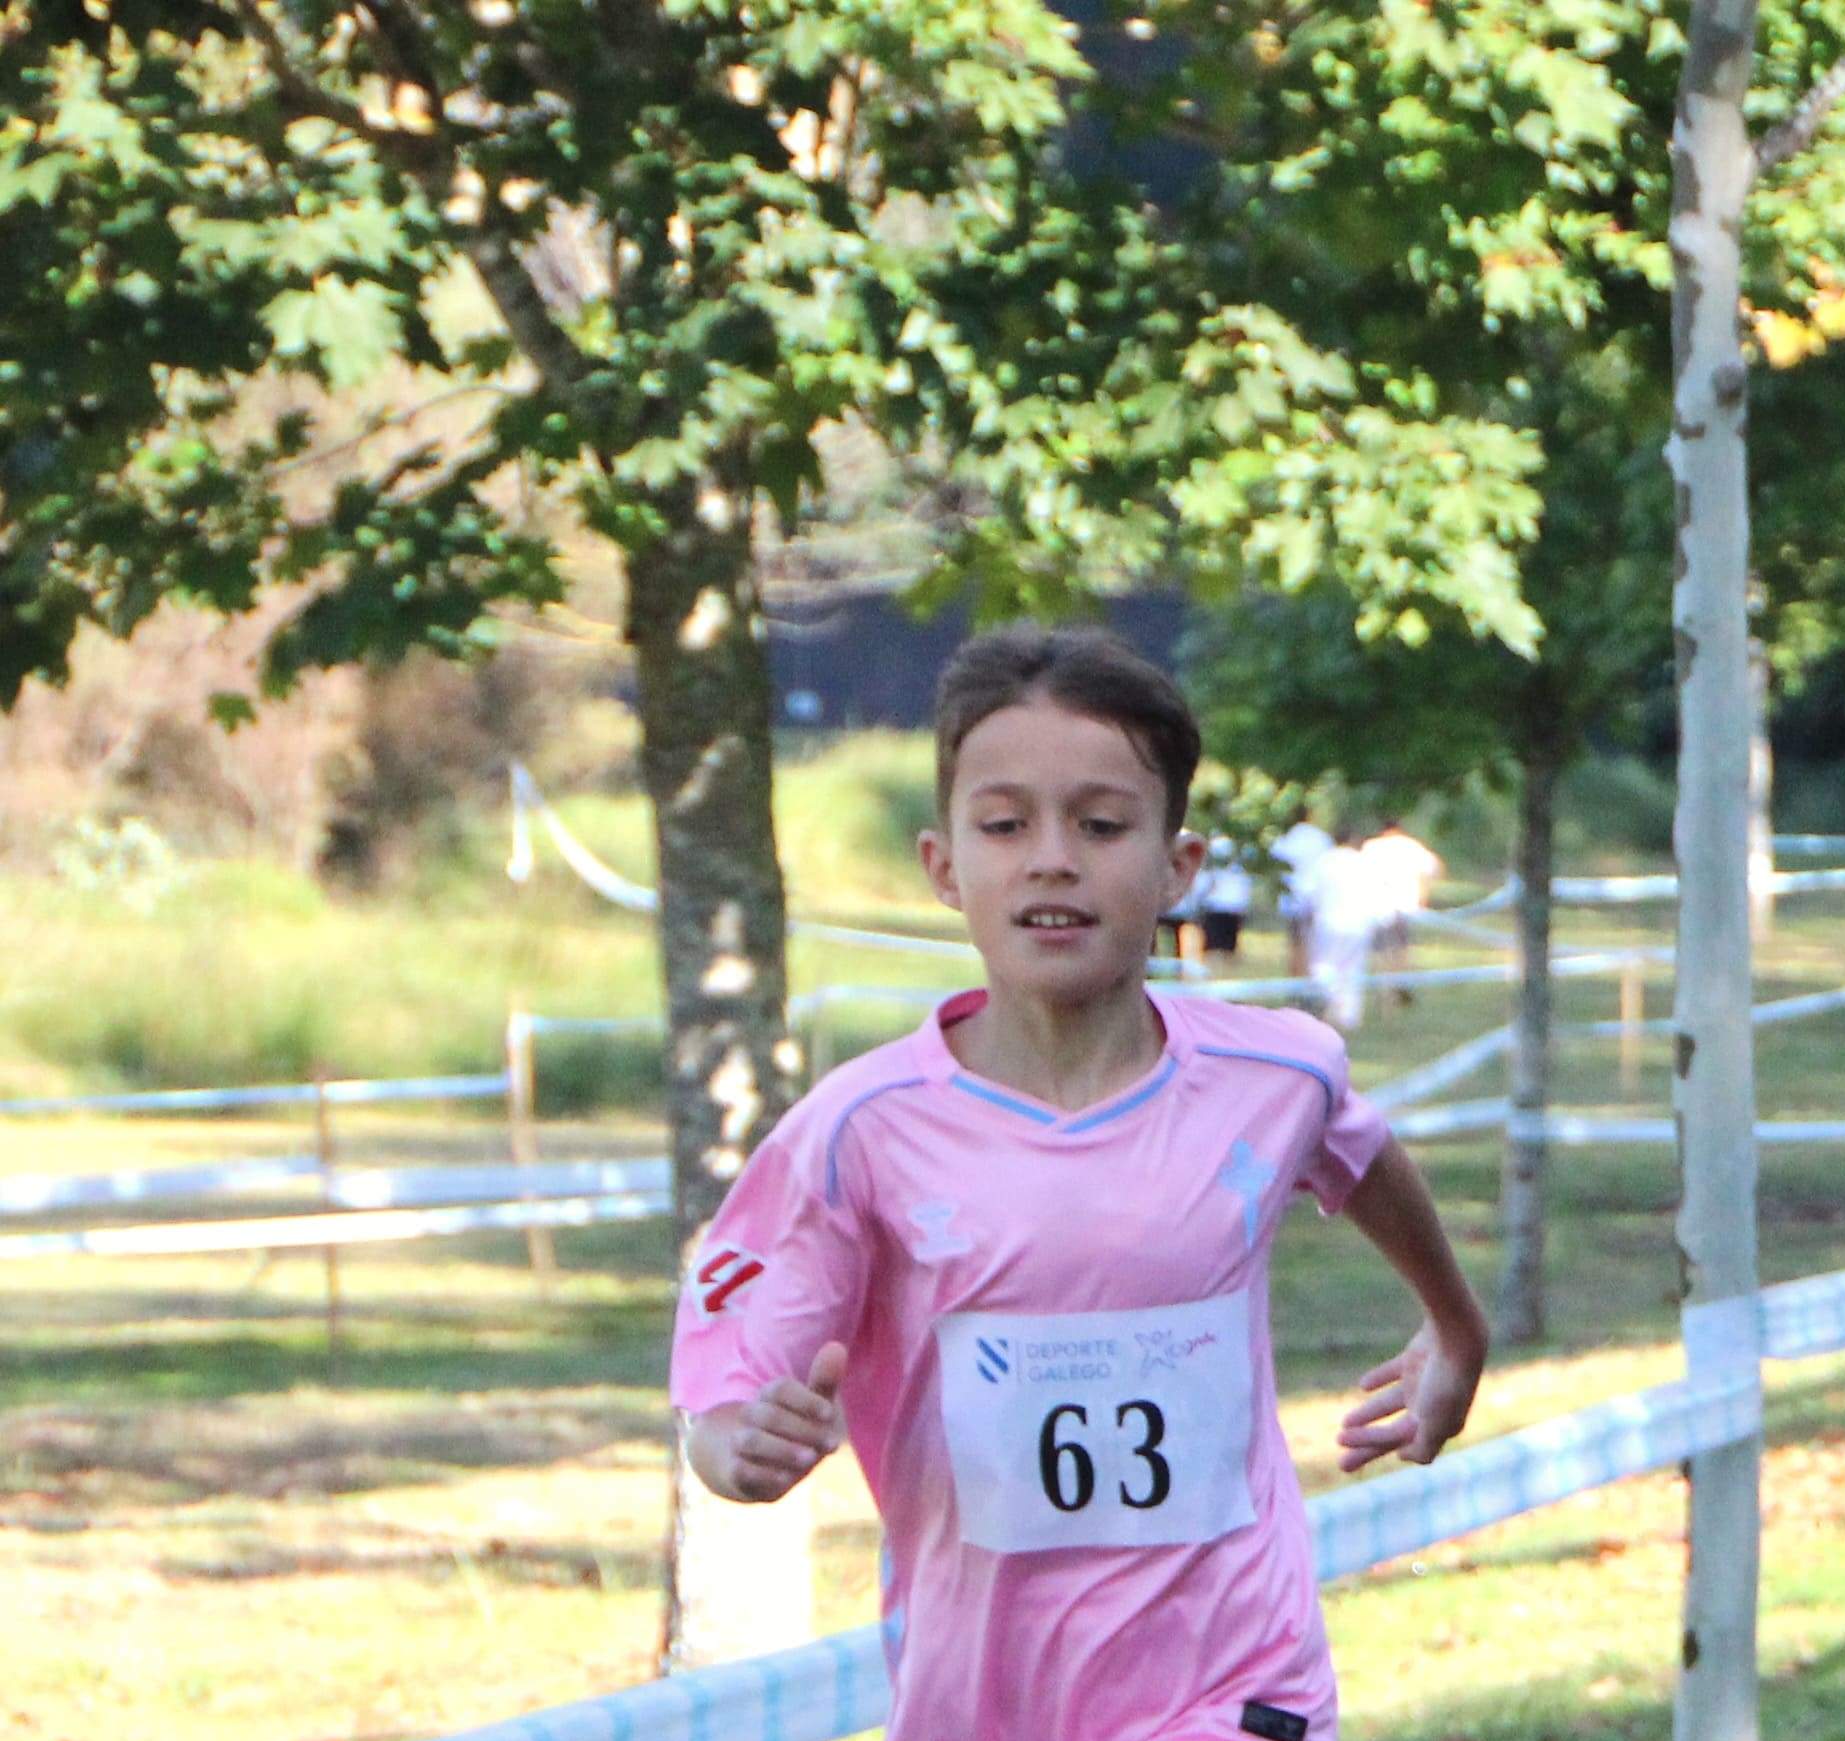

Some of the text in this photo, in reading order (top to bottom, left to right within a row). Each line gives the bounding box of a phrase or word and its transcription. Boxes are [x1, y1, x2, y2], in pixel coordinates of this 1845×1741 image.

[1025, 1338, 1118, 1359] DEPORTE
[1027, 1362, 1112, 1383] GALEGO
[1039, 1399, 1171, 1512] 63
